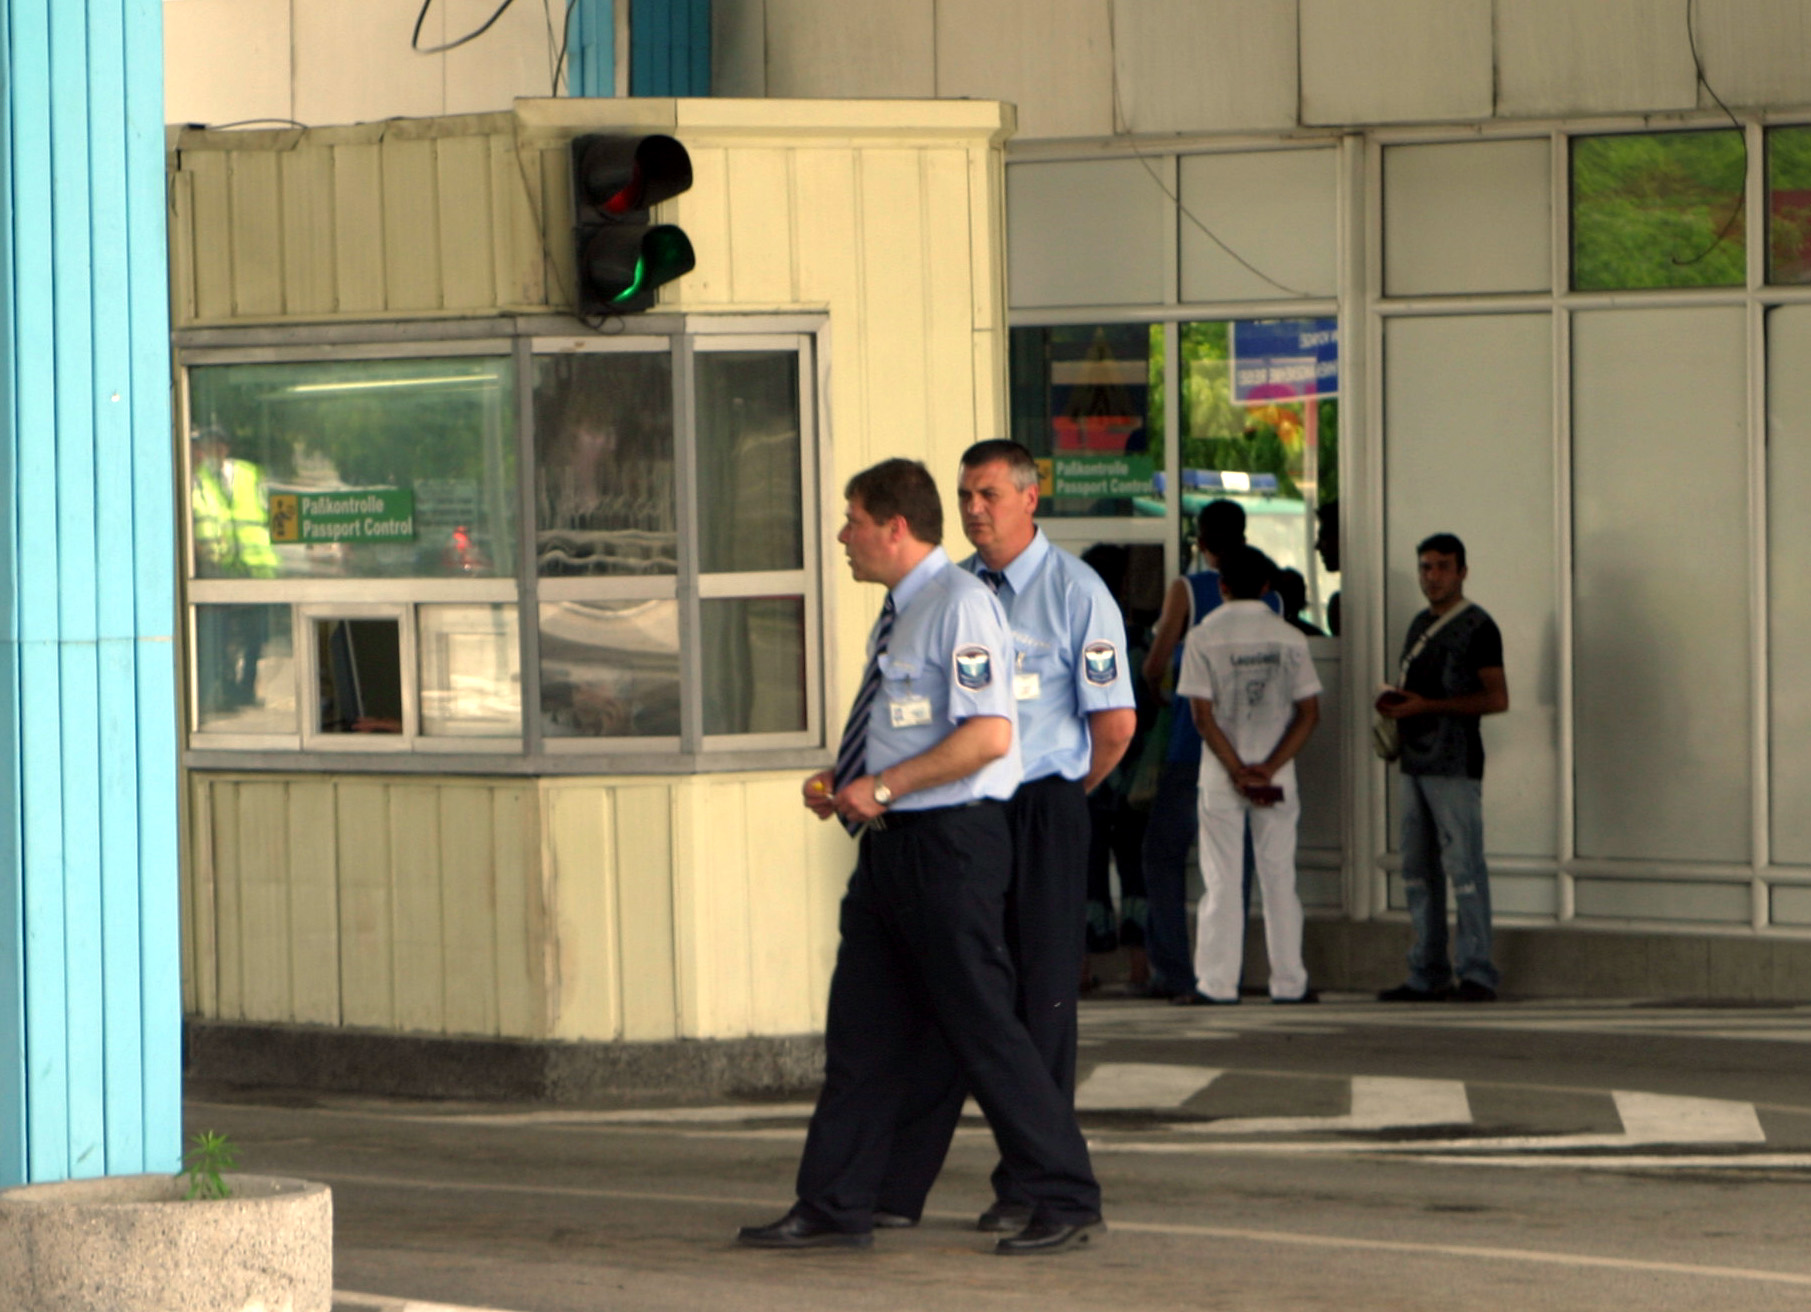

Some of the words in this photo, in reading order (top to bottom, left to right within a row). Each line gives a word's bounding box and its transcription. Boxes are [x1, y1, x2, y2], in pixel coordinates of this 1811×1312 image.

[1056, 479, 1108, 496] Passport
[1110, 478, 1153, 494] Control
[302, 496, 385, 515] Paßkontrolle
[302, 519, 361, 540] Passport
[364, 516, 413, 536] Control
